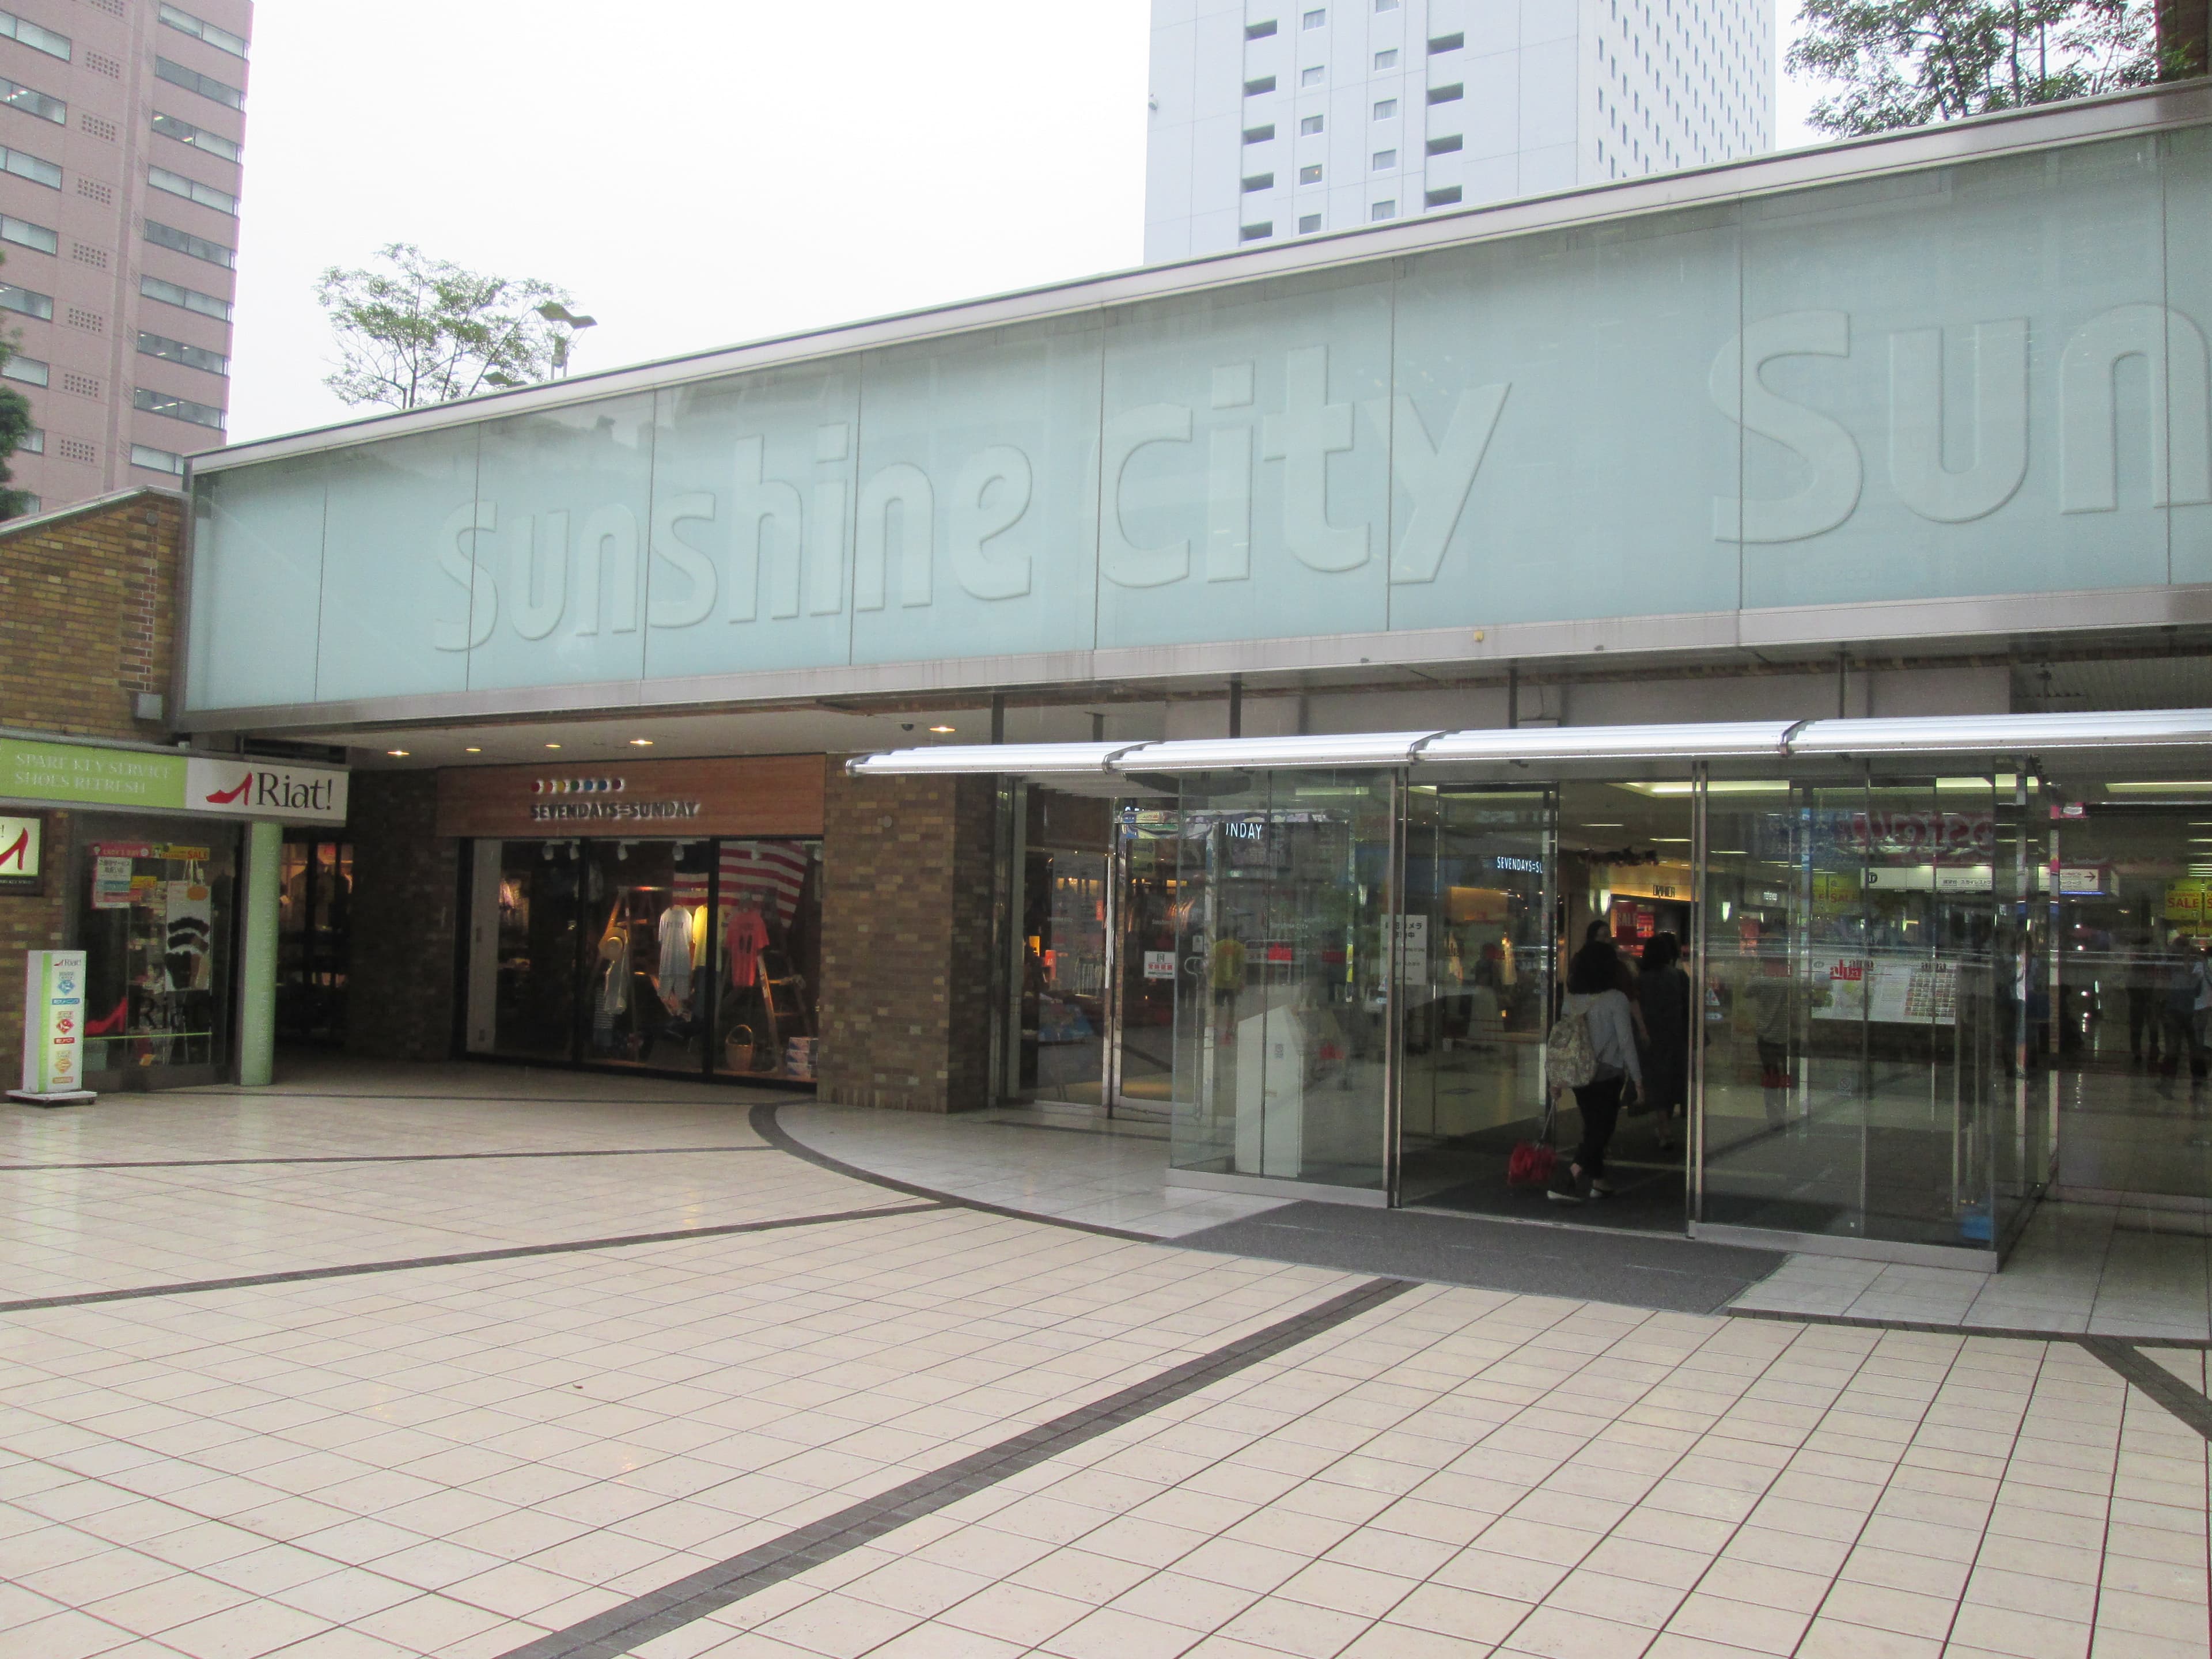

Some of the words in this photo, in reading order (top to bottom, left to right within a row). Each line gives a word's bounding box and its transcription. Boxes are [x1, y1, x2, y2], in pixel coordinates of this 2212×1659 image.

[15, 753, 67, 769] SPARE
[73, 759, 104, 772] KEY
[109, 762, 172, 779] SERVICE
[14, 772, 70, 788] SHOES
[75, 777, 146, 793] REFRESH
[256, 772, 332, 810] Riat!
[529, 801, 701, 821] SEVENDAYS=SUNDAY
[187, 850, 208, 859] SALE
[2167, 897, 2199, 908] SALE
